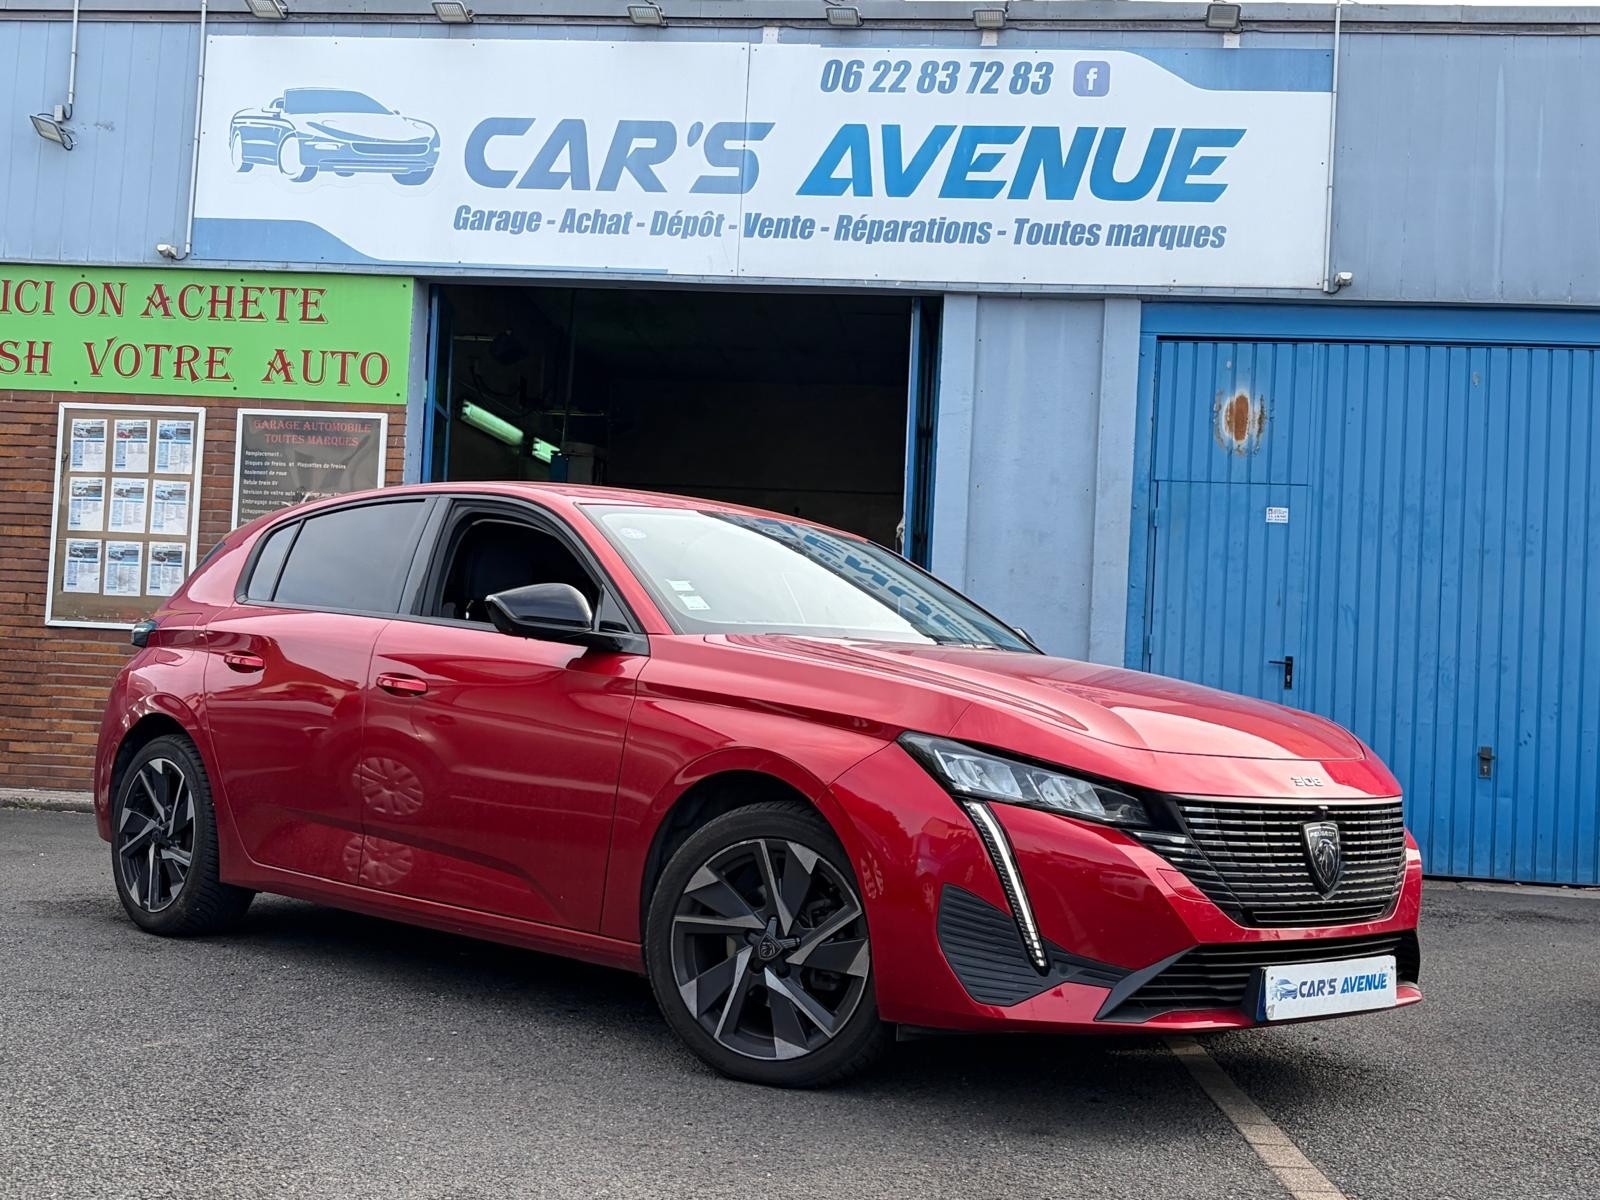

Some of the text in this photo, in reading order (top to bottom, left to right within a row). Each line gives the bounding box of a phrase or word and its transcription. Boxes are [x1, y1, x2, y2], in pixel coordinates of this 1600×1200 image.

[820, 59, 1055, 96] 06 22 83 72 83
[464, 117, 1248, 204] CAR'S AVENUE
[453, 204, 543, 235] Garage
[558, 208, 634, 235] Achat
[649, 210, 726, 240] Dépôt
[743, 212, 816, 240] Vente
[833, 213, 991, 245] Réparations
[1012, 219, 1103, 247] Toutes
[1104, 222, 1228, 251] marques
[0, 279, 328, 325] ICI ON ACHETE
[82, 335, 235, 382] VOTRE
[261, 348, 389, 387] AUTO
[254, 420, 371, 433] GARAGE AUTOMOBILE
[264, 433, 359, 447] TOUTES MARQUES
[1298, 972, 1388, 999] CAR'S AVENUE
